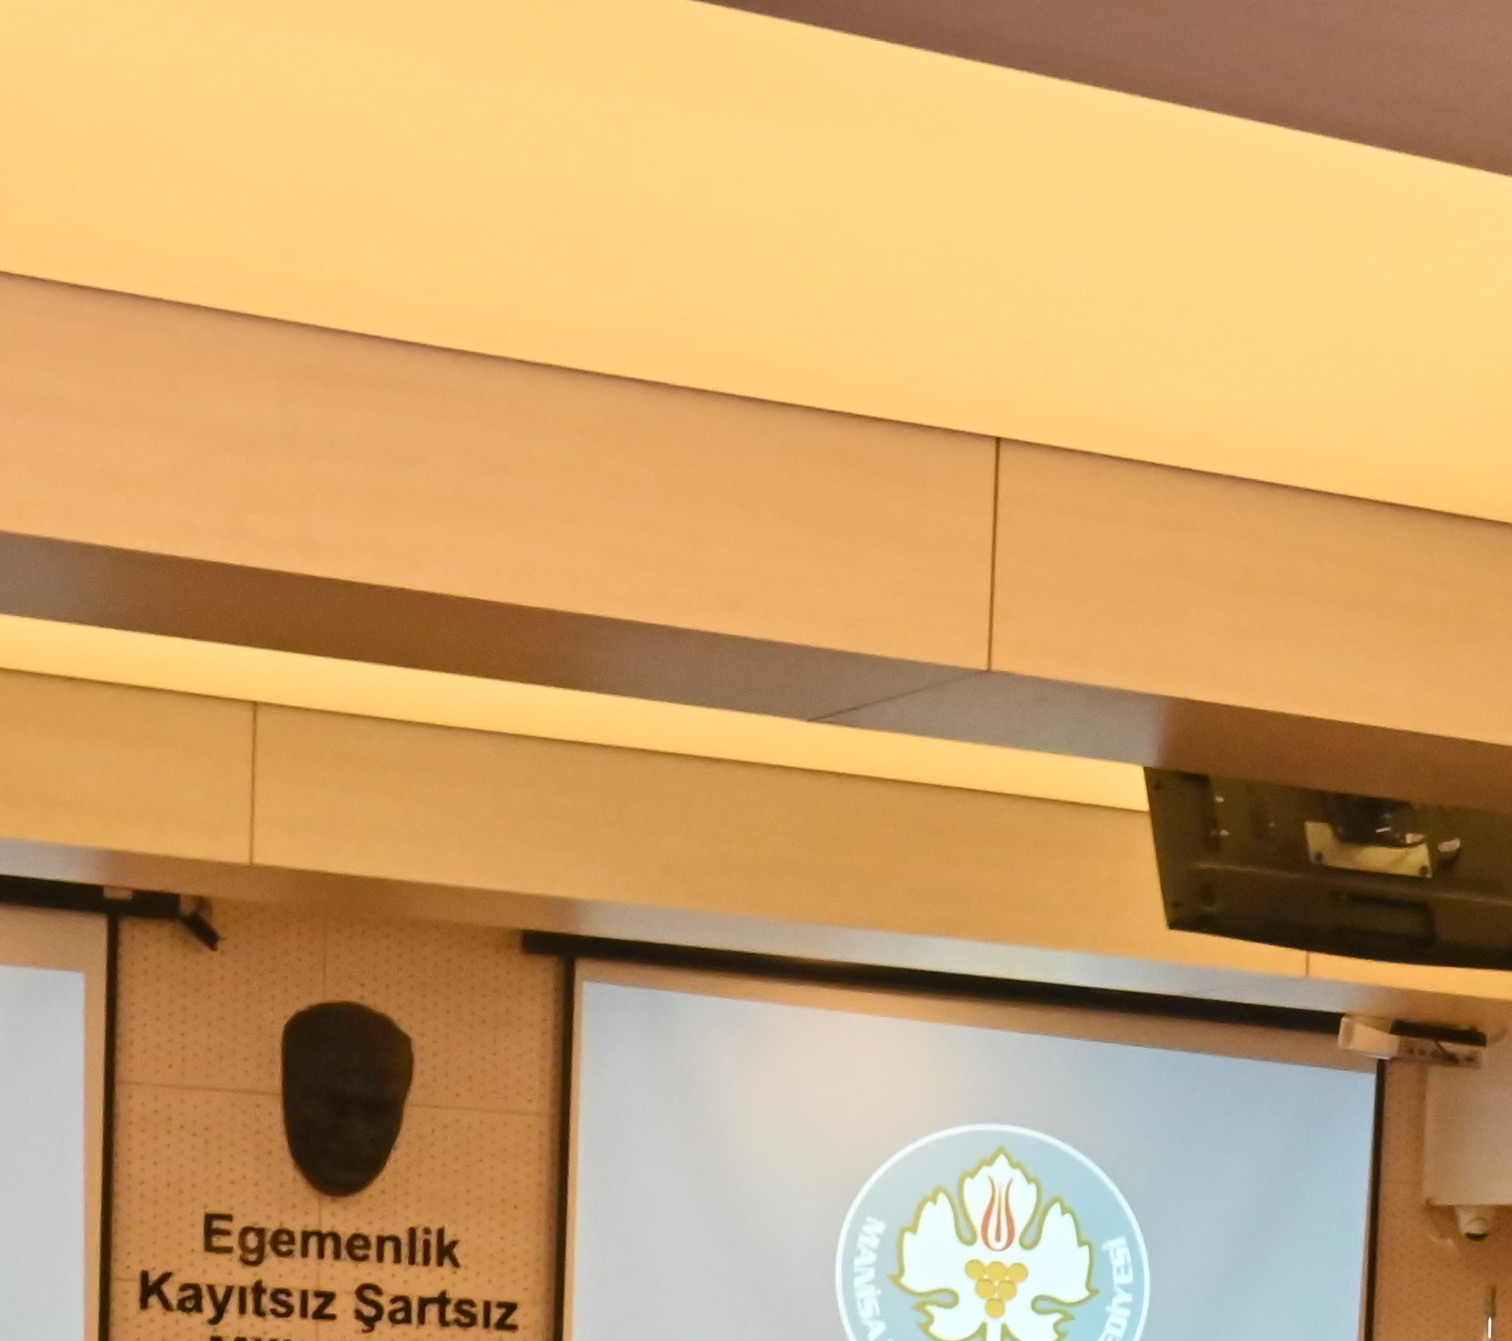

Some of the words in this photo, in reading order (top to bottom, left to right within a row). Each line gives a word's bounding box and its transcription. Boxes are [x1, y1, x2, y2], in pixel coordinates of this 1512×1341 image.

[203, 1212, 460, 1268] Egemenlik
[139, 1270, 337, 1325] Kayıtsız
[354, 1283, 519, 1333] Şartsız
[853, 1216, 887, 1341] MANİSA
